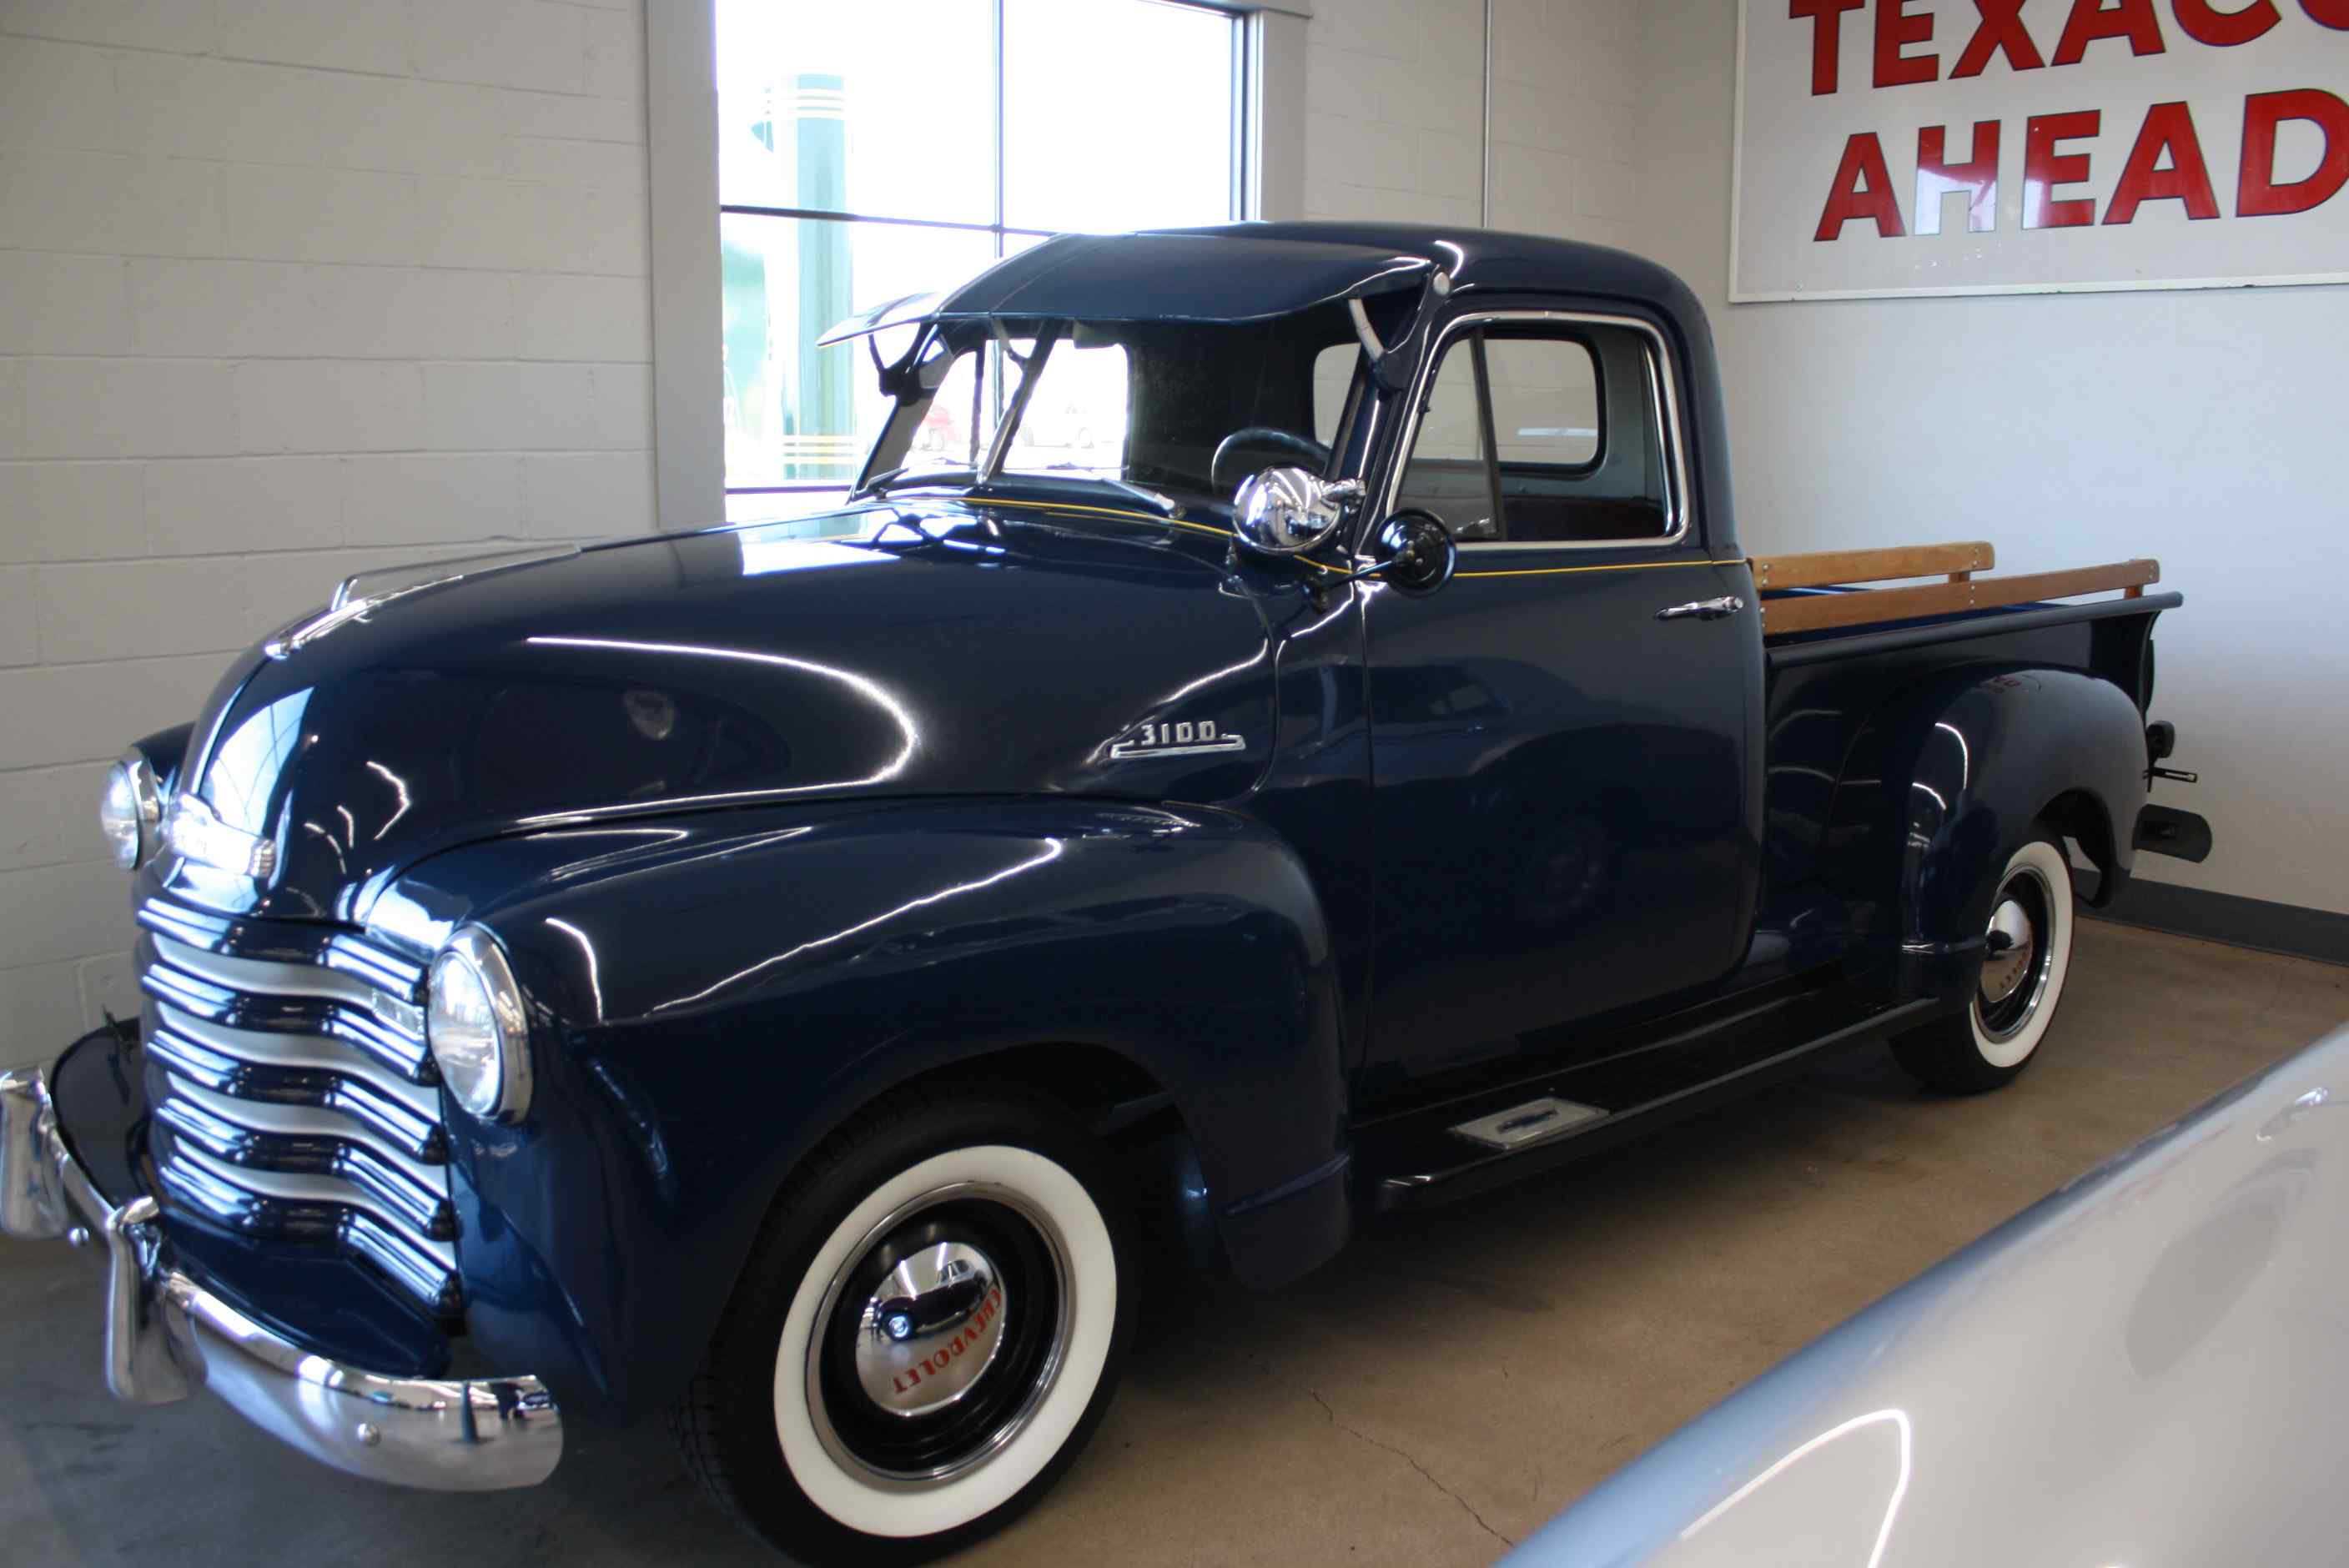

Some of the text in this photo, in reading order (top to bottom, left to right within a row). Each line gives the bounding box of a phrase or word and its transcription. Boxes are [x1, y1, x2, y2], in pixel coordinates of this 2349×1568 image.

[1788, 0, 2349, 96] TEXA
[1813, 88, 2349, 242] AHEAD
[1140, 720, 1216, 746] 3100
[893, 1288, 1001, 1394] CHEVROLET
